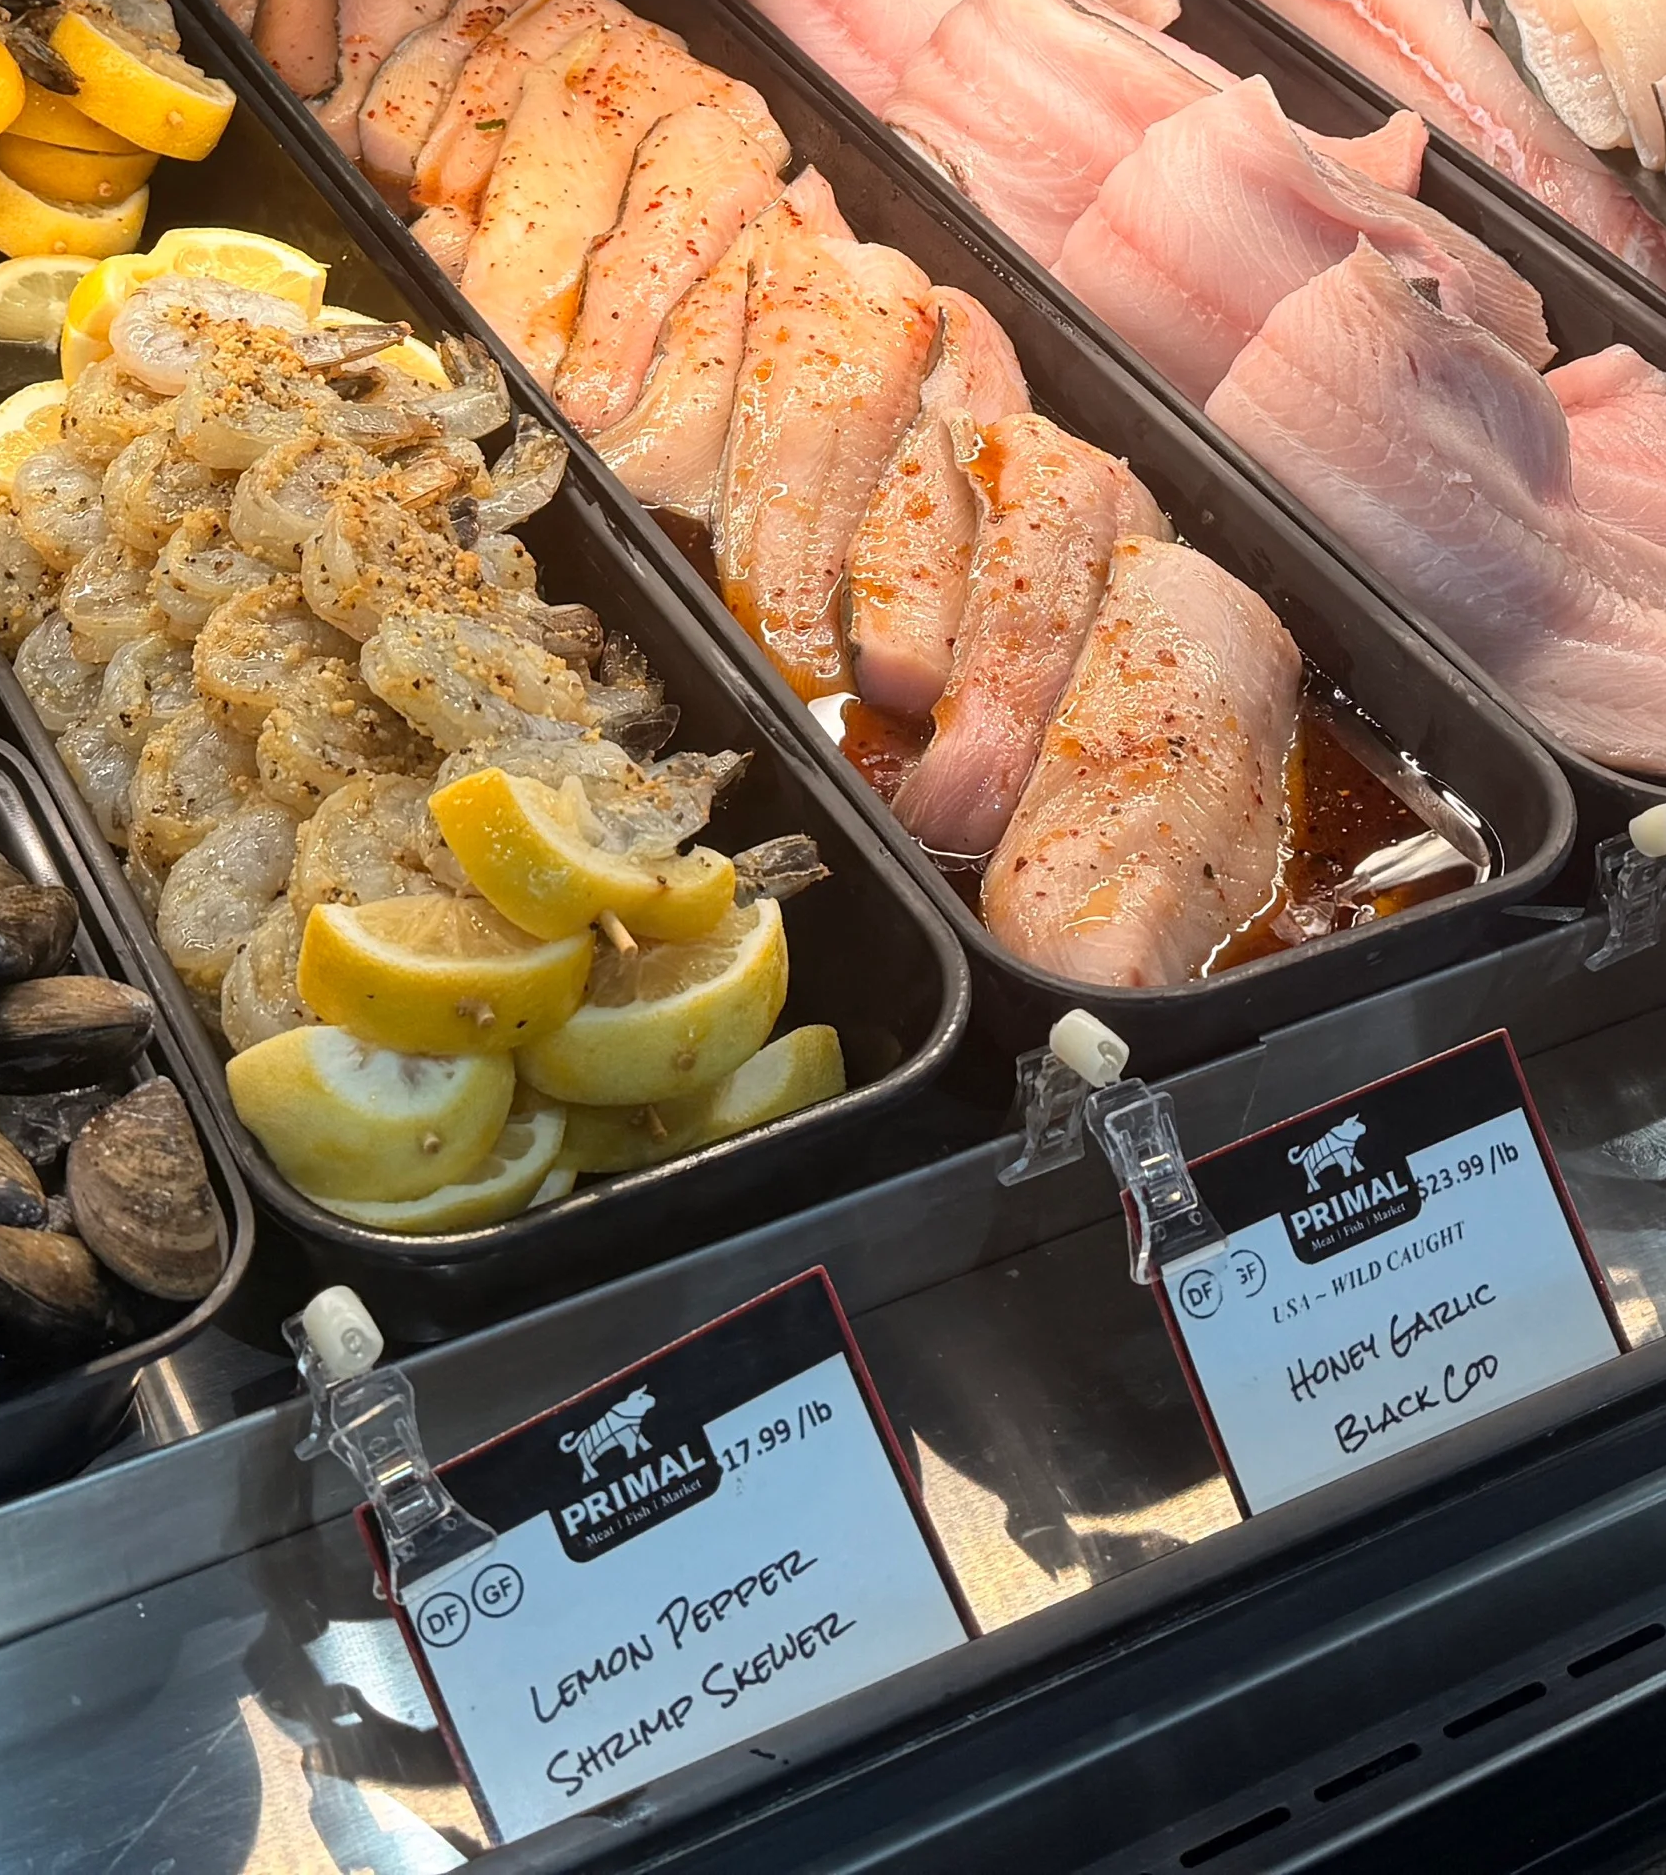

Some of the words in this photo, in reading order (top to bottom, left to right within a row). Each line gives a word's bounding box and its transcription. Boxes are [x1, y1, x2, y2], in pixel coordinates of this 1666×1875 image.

[1290, 1170, 1409, 1239] PRIMAL
[1417, 1156, 1485, 1203] $23.99
[1490, 1141, 1519, 1176] /lb
[1311, 1235, 1335, 1252] Meat
[1343, 1220, 1364, 1237] Fish
[1373, 1203, 1406, 1224] Market
[1188, 1281, 1213, 1306] DF
[1273, 1294, 1310, 1323] USA
[1331, 1261, 1382, 1297] WILD
[1387, 1220, 1465, 1270] CAUGHT
[1287, 1333, 1381, 1402] HONEY
[1390, 1283, 1497, 1359] GARLIC
[799, 1400, 833, 1441] /lb
[1335, 1385, 1440, 1453] BLACK
[1444, 1353, 1498, 1404] COD
[560, 1444, 706, 1537] PRIMAL
[585, 1526, 615, 1547] Meat
[625, 1506, 651, 1526] Fish
[661, 1479, 702, 1507] Market
[426, 1607, 459, 1634] DF
[483, 1577, 513, 1603] GF
[530, 1635, 654, 1723] LEMON
[657, 1549, 818, 1648] PEPPER
[546, 1697, 693, 1796] SHRIMP
[703, 1612, 857, 1709] SKEWER
